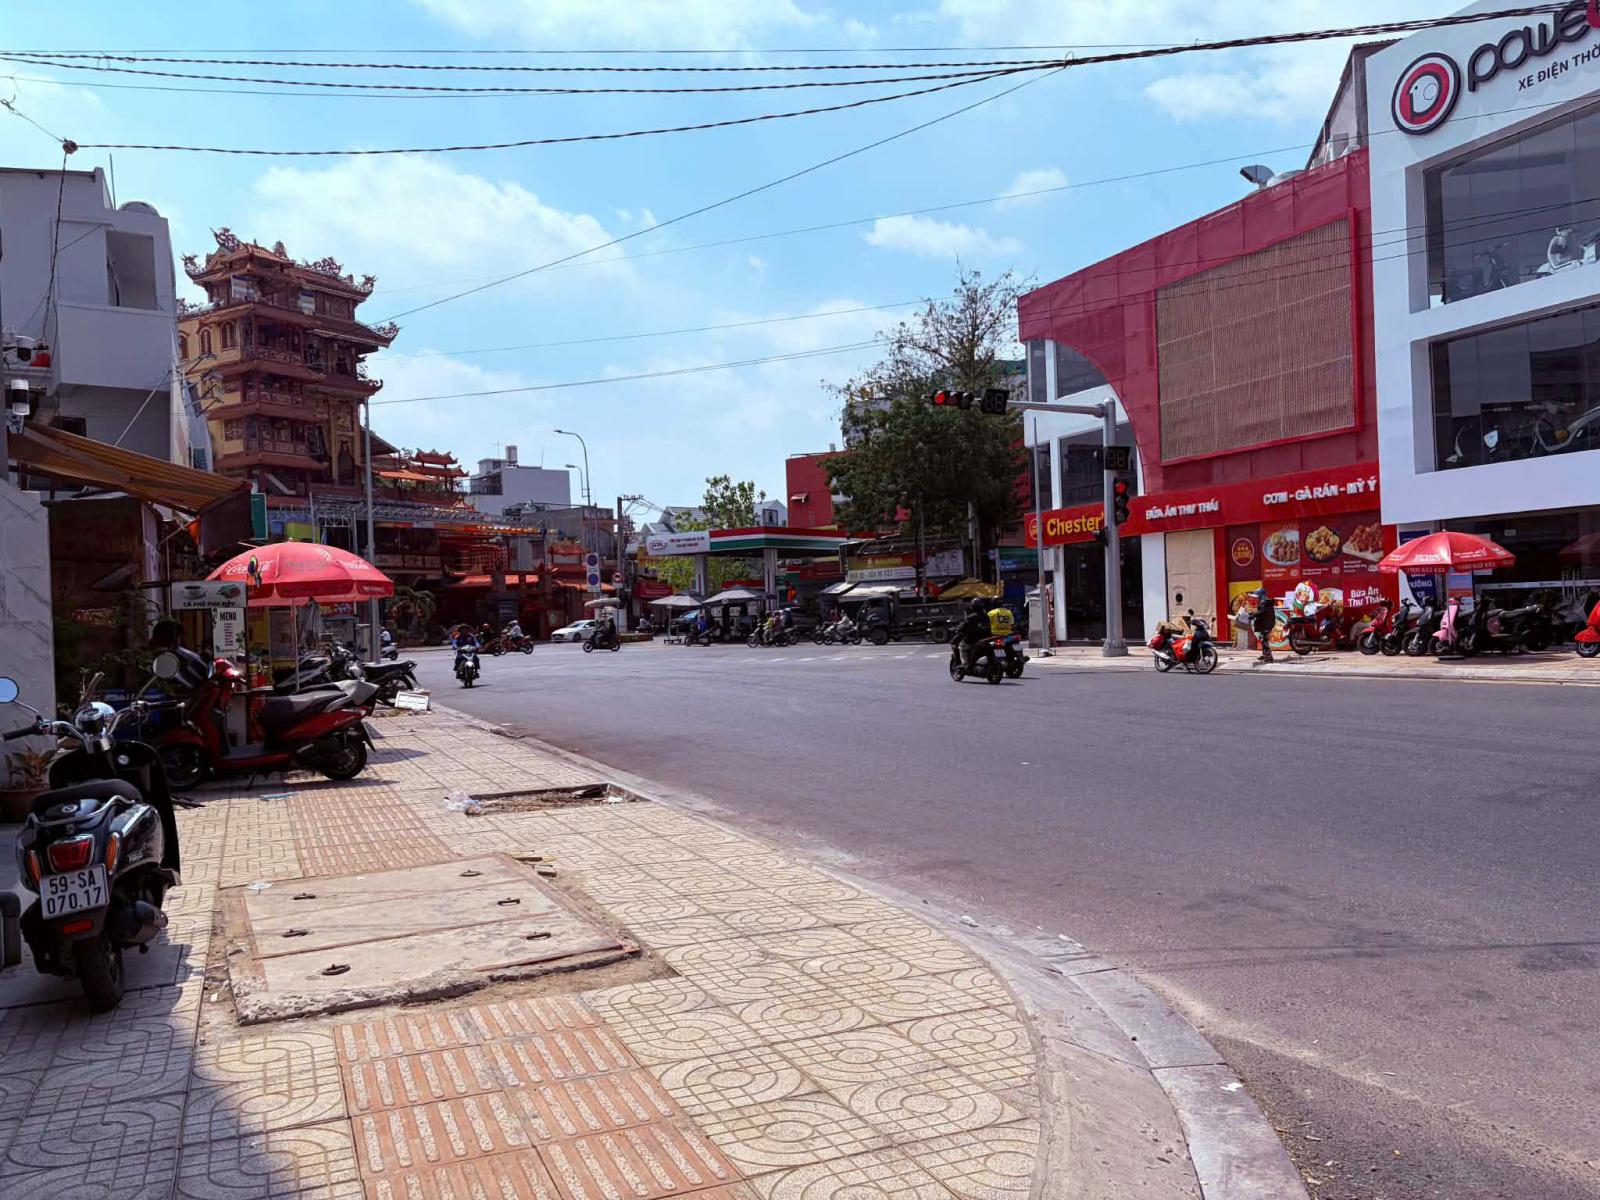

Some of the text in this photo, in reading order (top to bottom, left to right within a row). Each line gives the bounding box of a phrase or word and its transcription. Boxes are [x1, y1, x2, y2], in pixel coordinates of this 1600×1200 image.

[1518, 74, 1535, 92] XE
[1537, 58, 1569, 83] ĐIỆN
[1262, 491, 1288, 505] CƠM
[1295, 485, 1312, 501] GÀ
[1313, 482, 1339, 499] RÁN
[1046, 513, 1106, 537] Chester'
[219, 611, 237, 621] MENU
[49, 869, 97, 896] 59-SA
[46, 886, 102, 915] 070.17
